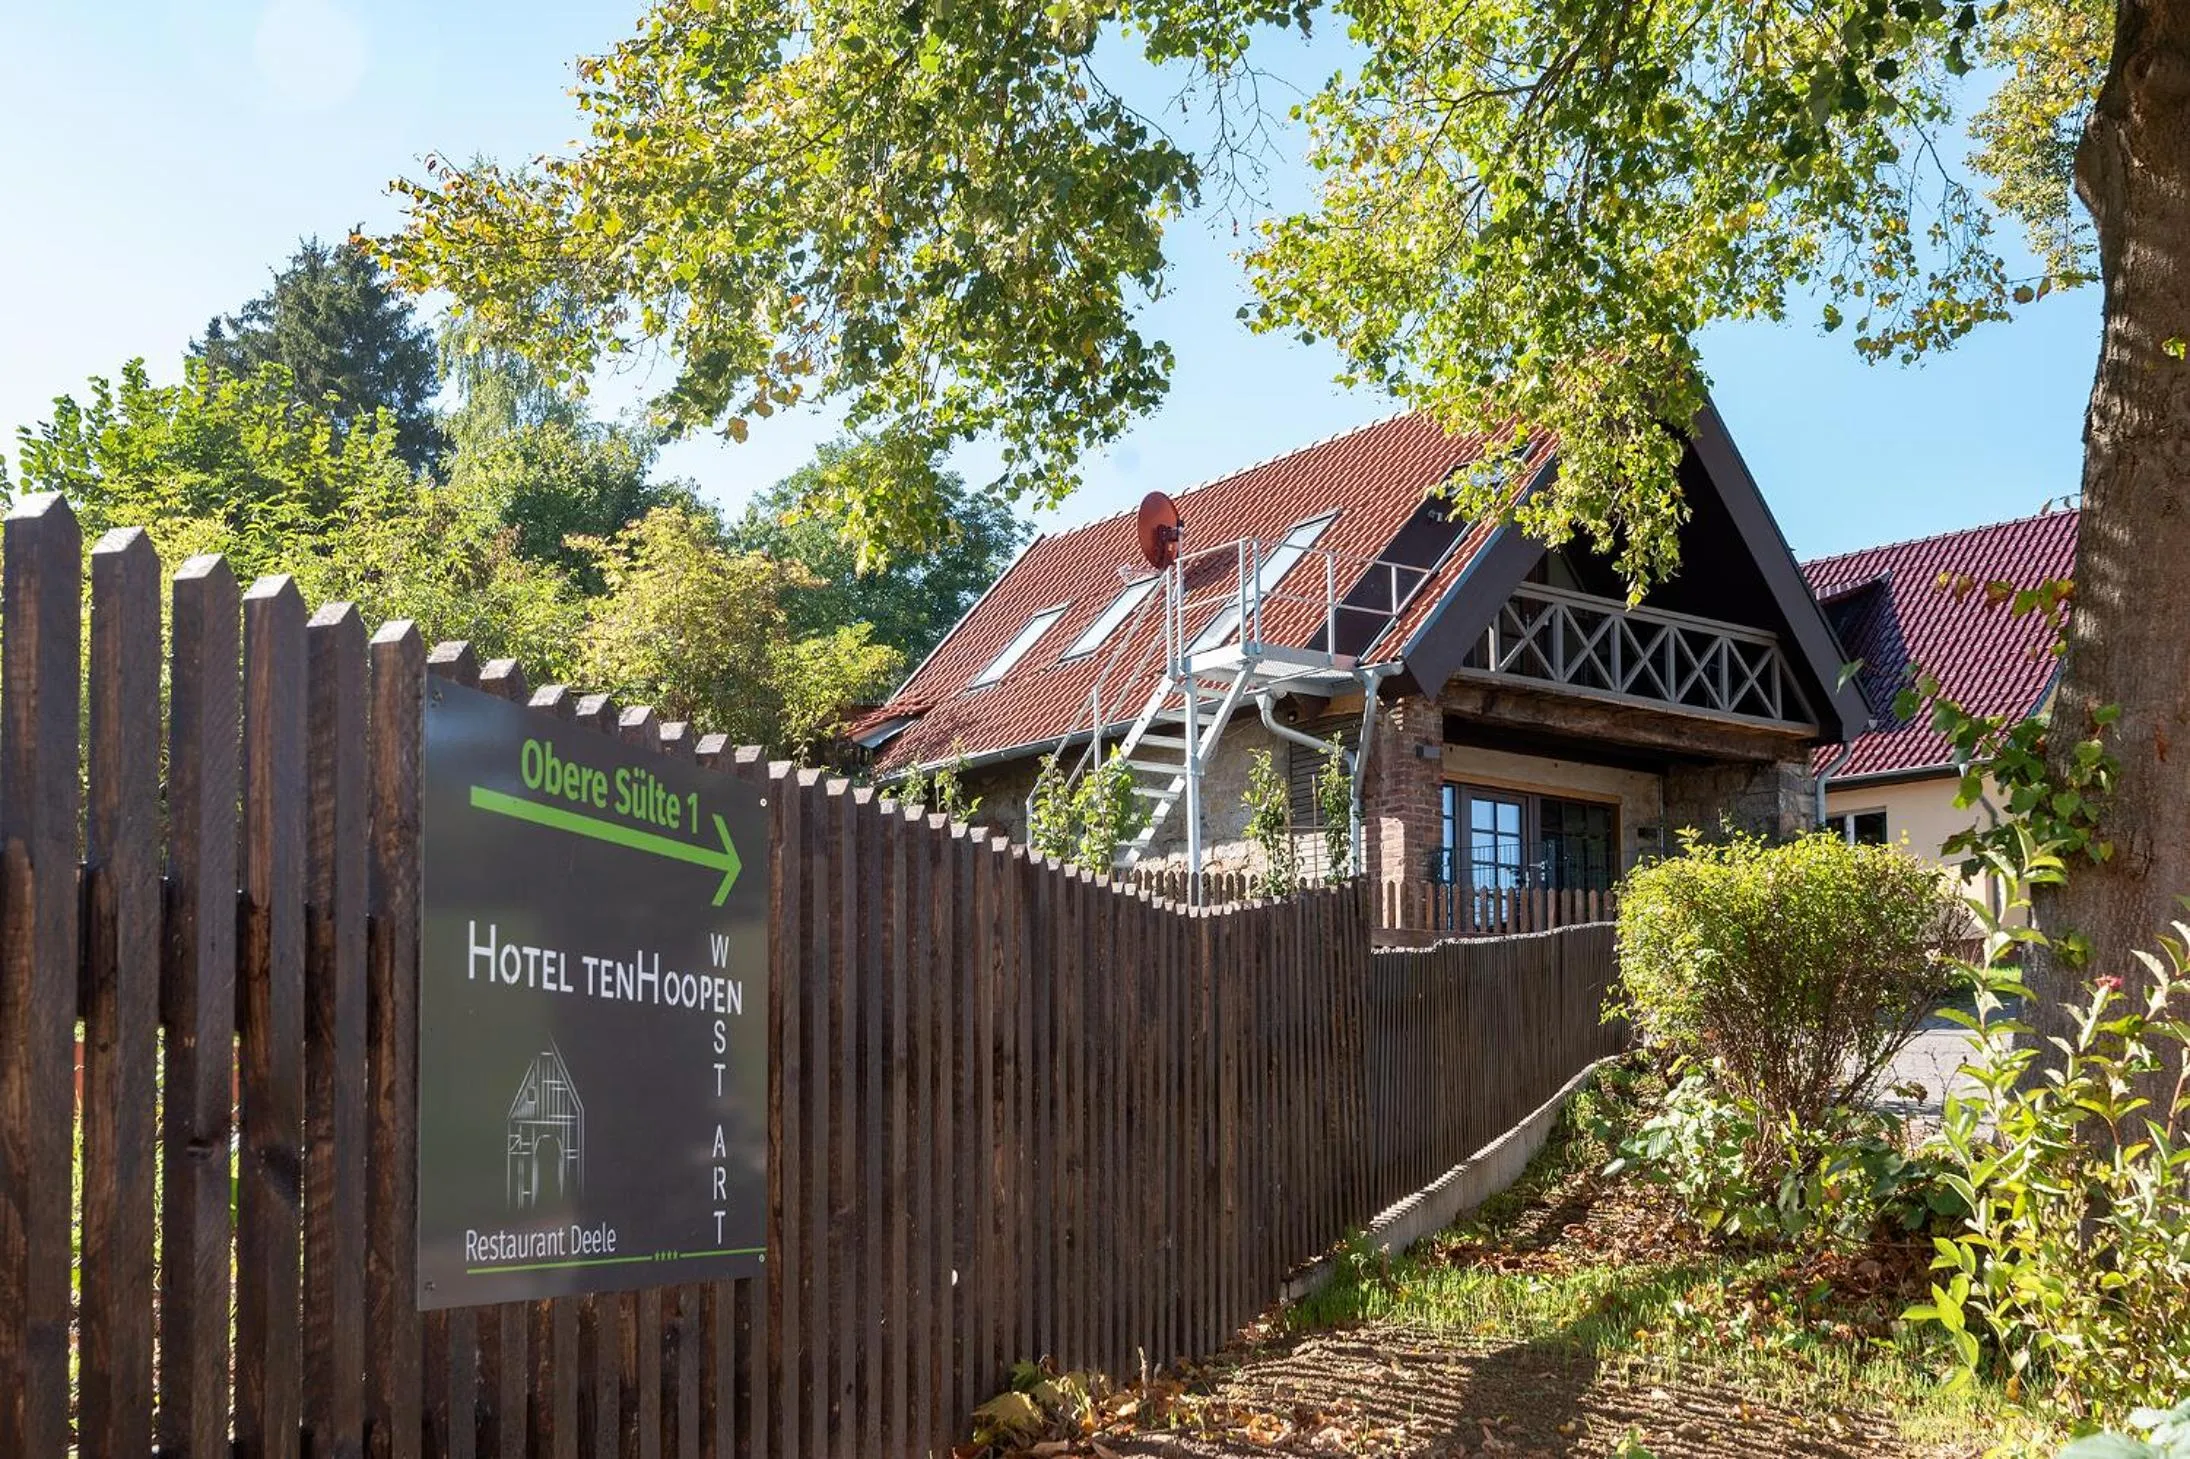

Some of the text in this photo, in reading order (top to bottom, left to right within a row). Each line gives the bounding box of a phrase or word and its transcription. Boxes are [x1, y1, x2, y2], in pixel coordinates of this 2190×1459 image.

[521, 738, 698, 834] Obere Sülte 1
[468, 920, 574, 993] HOTEL
[712, 1124, 727, 1245] ART
[466, 1221, 617, 1262] Restaurant Deele
